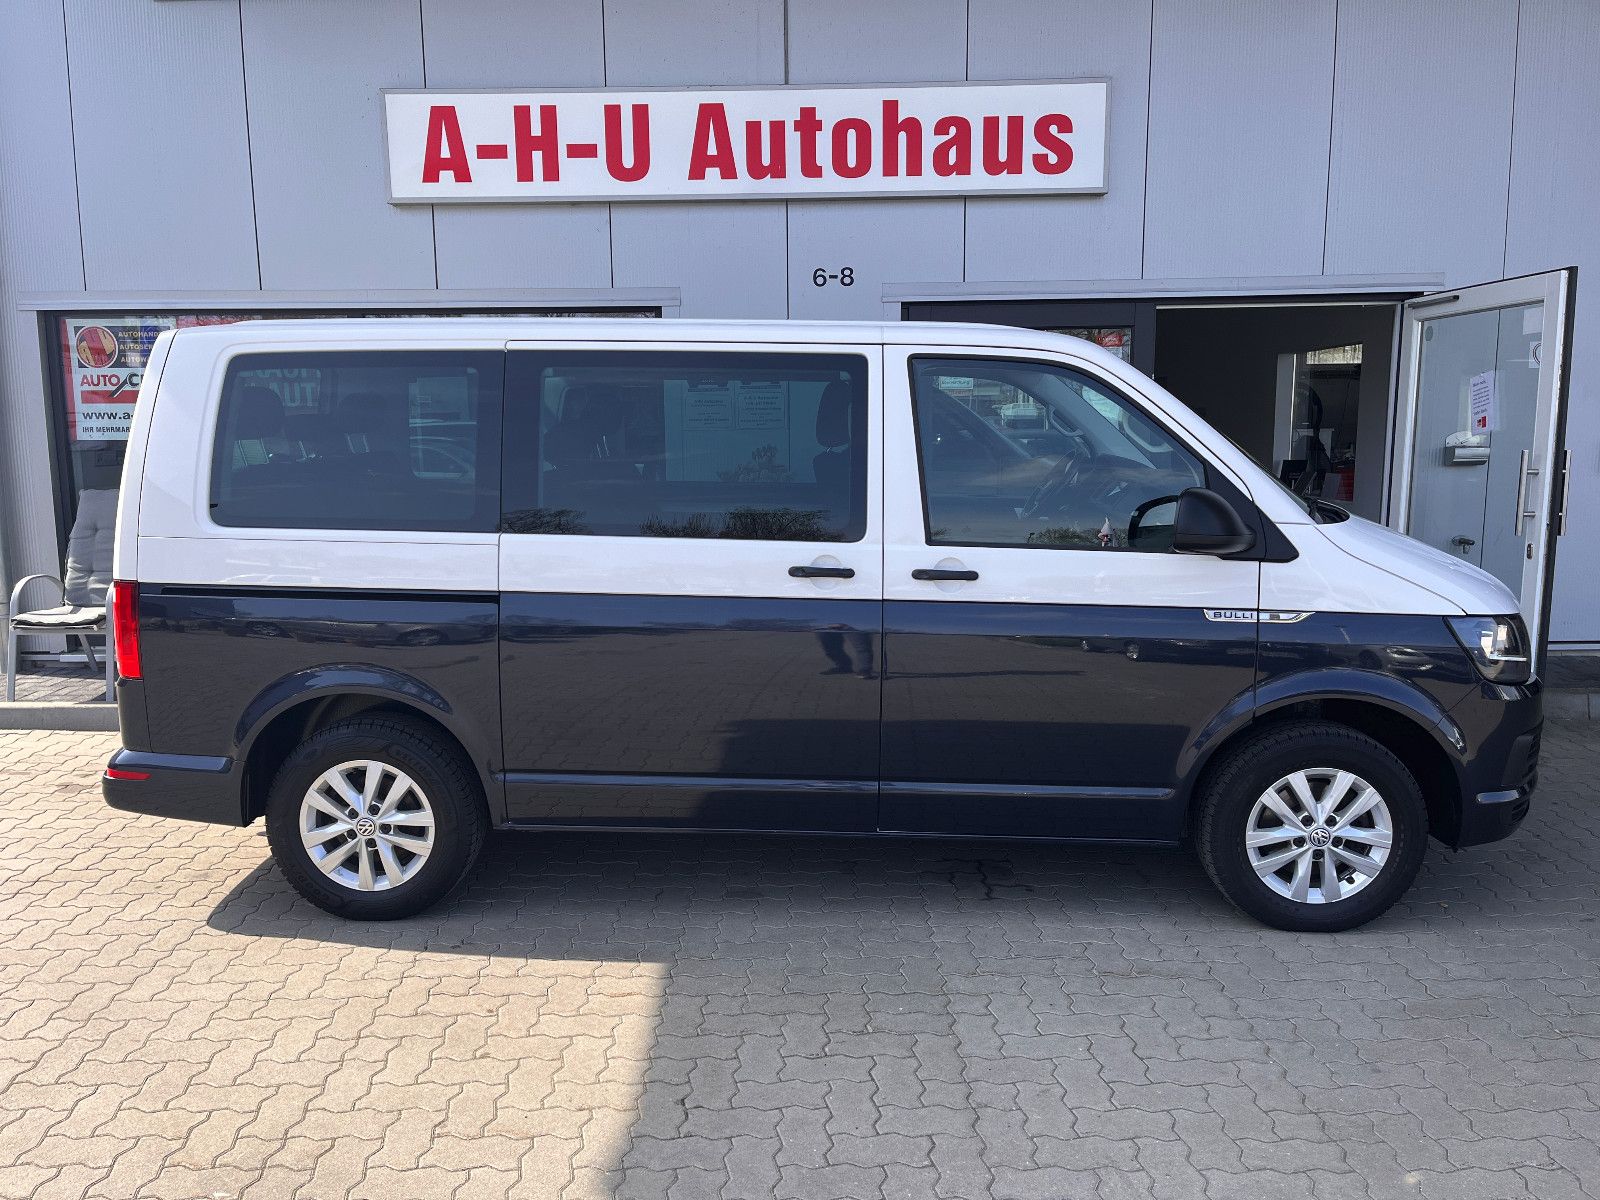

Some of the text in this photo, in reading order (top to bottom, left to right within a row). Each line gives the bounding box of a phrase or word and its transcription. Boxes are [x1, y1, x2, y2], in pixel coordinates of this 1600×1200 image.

[423, 99, 1074, 184] A-H-U Autohaus
[813, 267, 854, 287] 6-8
[81, 374, 120, 387] AUTO
[1213, 611, 1253, 619] BULLI
